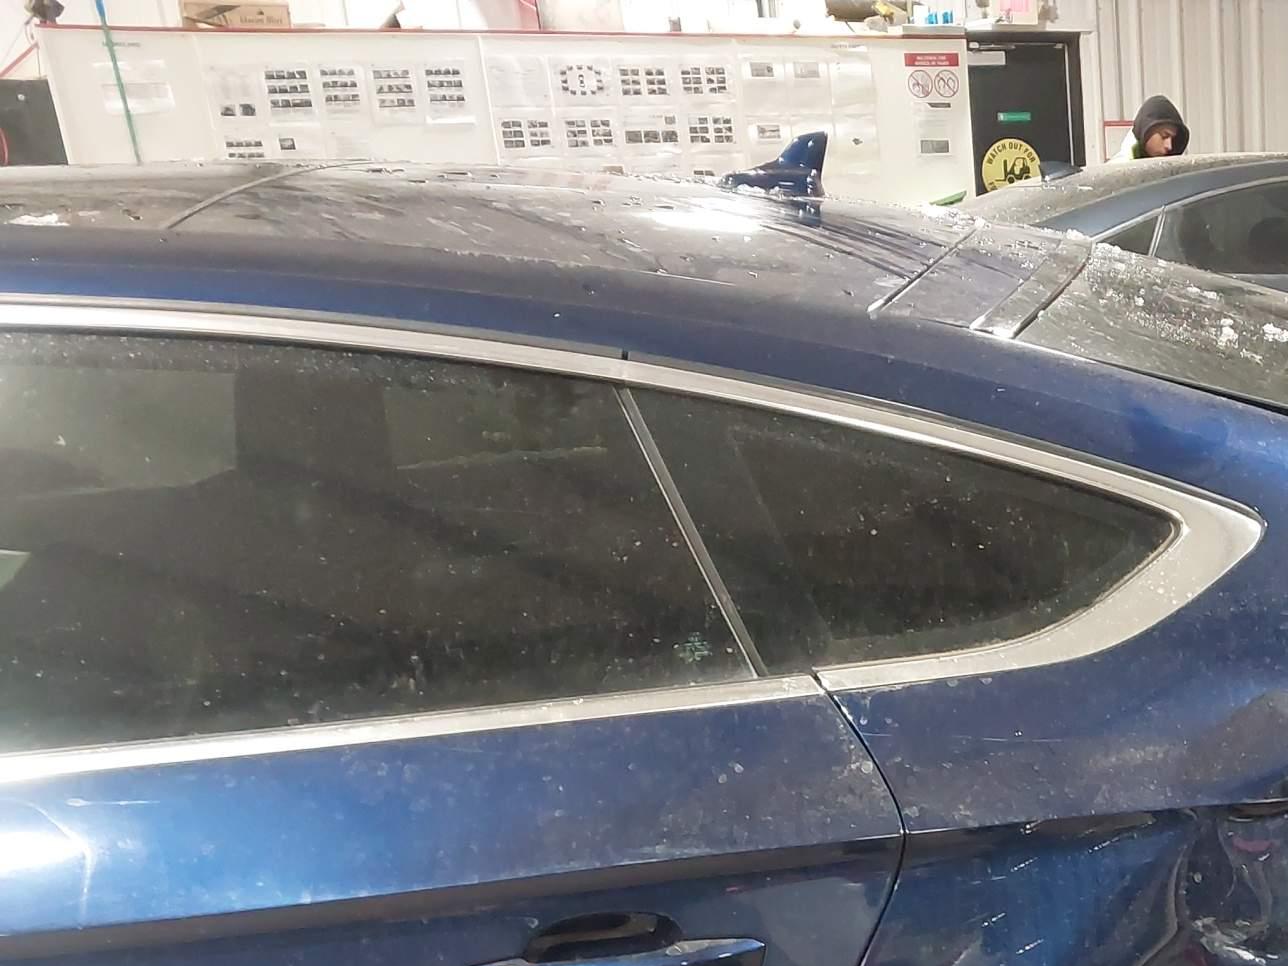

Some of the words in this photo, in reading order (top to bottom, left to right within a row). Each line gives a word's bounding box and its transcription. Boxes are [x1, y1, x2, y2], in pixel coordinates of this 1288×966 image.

[986, 143, 1006, 164] WATCH
[1008, 142, 1023, 151] OUT
[1023, 148, 1036, 162] FOR
